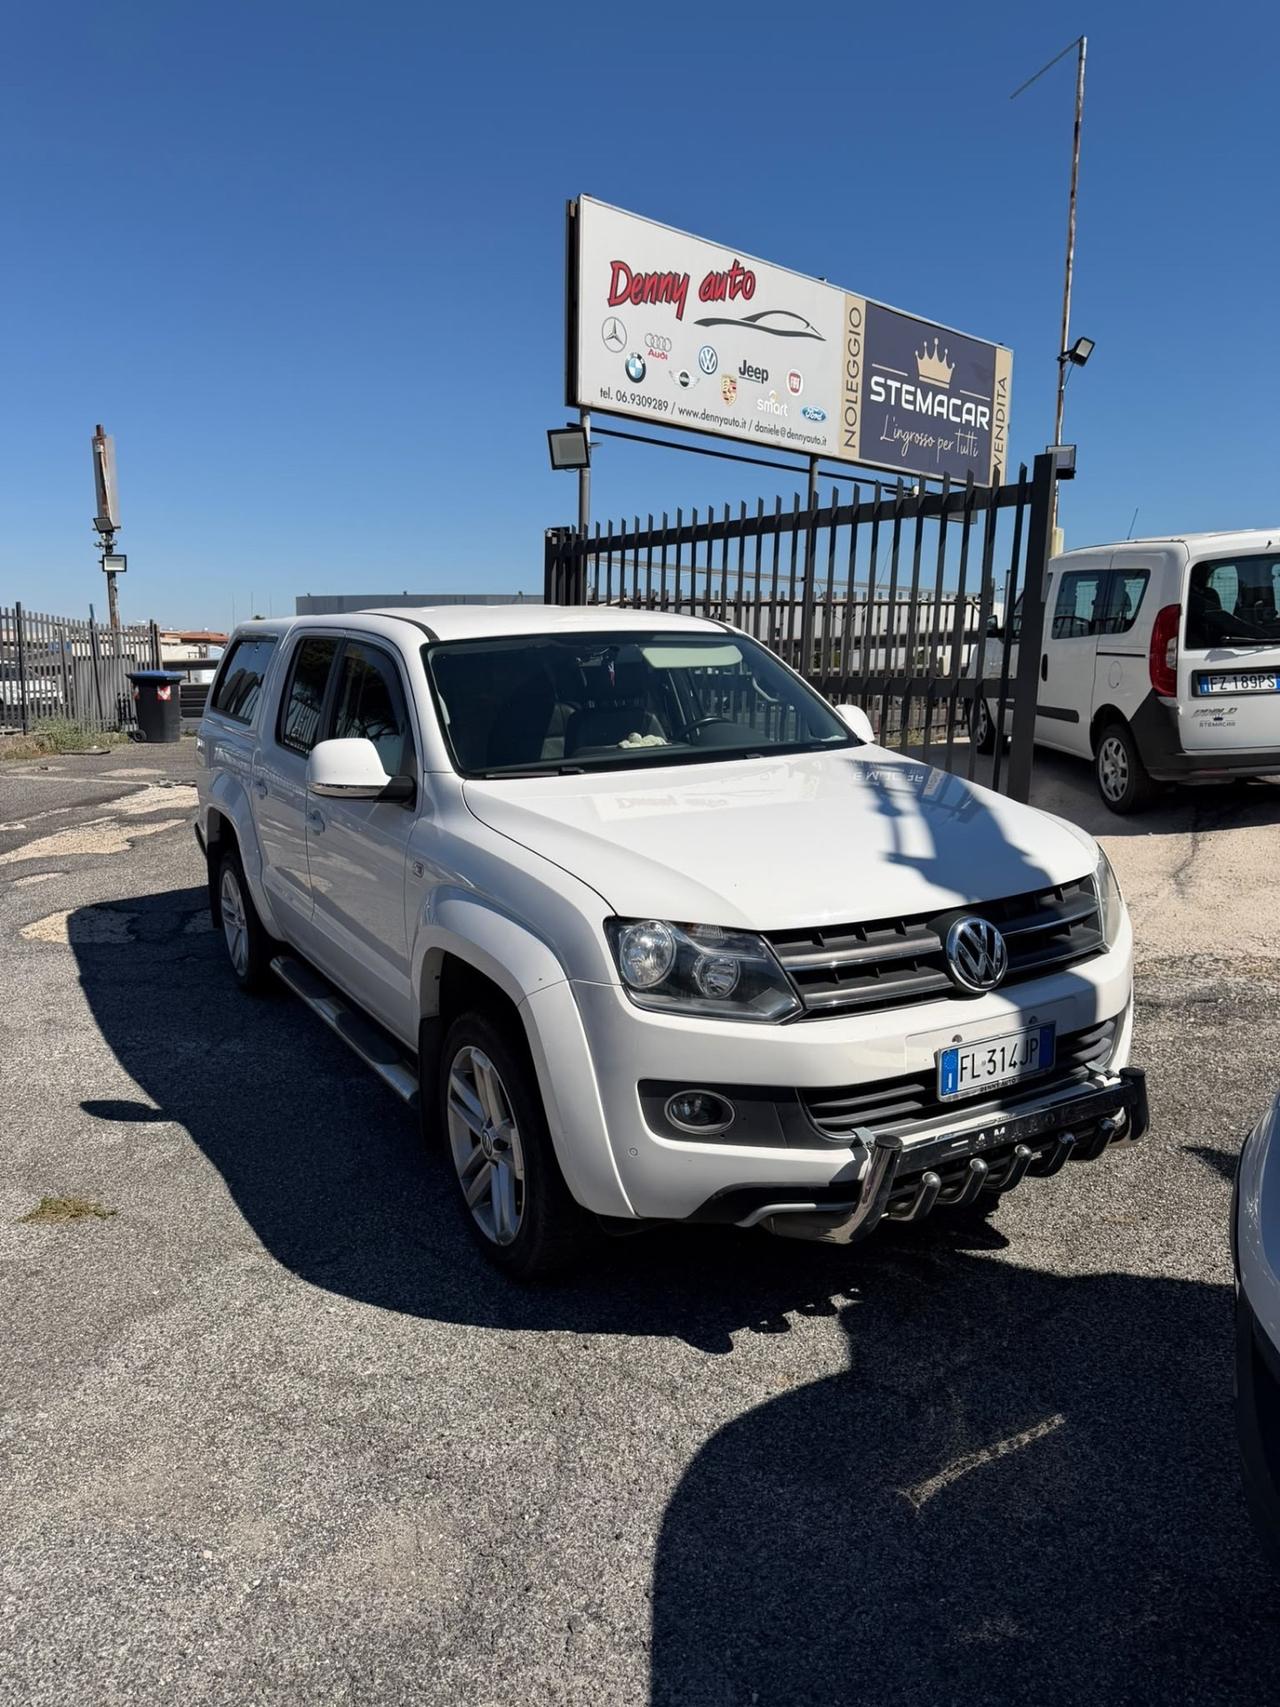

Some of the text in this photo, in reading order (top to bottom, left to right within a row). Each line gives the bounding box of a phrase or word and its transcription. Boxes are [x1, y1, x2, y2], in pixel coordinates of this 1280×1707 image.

[607, 258, 756, 321] Denny auto
[647, 349, 668, 360] Audi
[738, 359, 769, 384] Jeep
[844, 307, 862, 449] NOLEGGIO
[600, 387, 613, 401] tel.
[615, 390, 669, 412] 06.9309289
[677, 406, 747, 430] www.dennyauto.it
[754, 421, 828, 447] daniele@dennyauto.it
[756, 398, 788, 417] smart
[804, 406, 825, 421] Ford
[870, 375, 990, 431] STEMACAR
[993, 376, 1008, 467] VENDITA
[880, 414, 935, 457] L'ingrosso
[936, 437, 955, 464] per
[1209, 674, 1275, 691] FZ 189PS
[959, 1052, 981, 1083] FL
[986, 1037, 1039, 1076] 314JP
